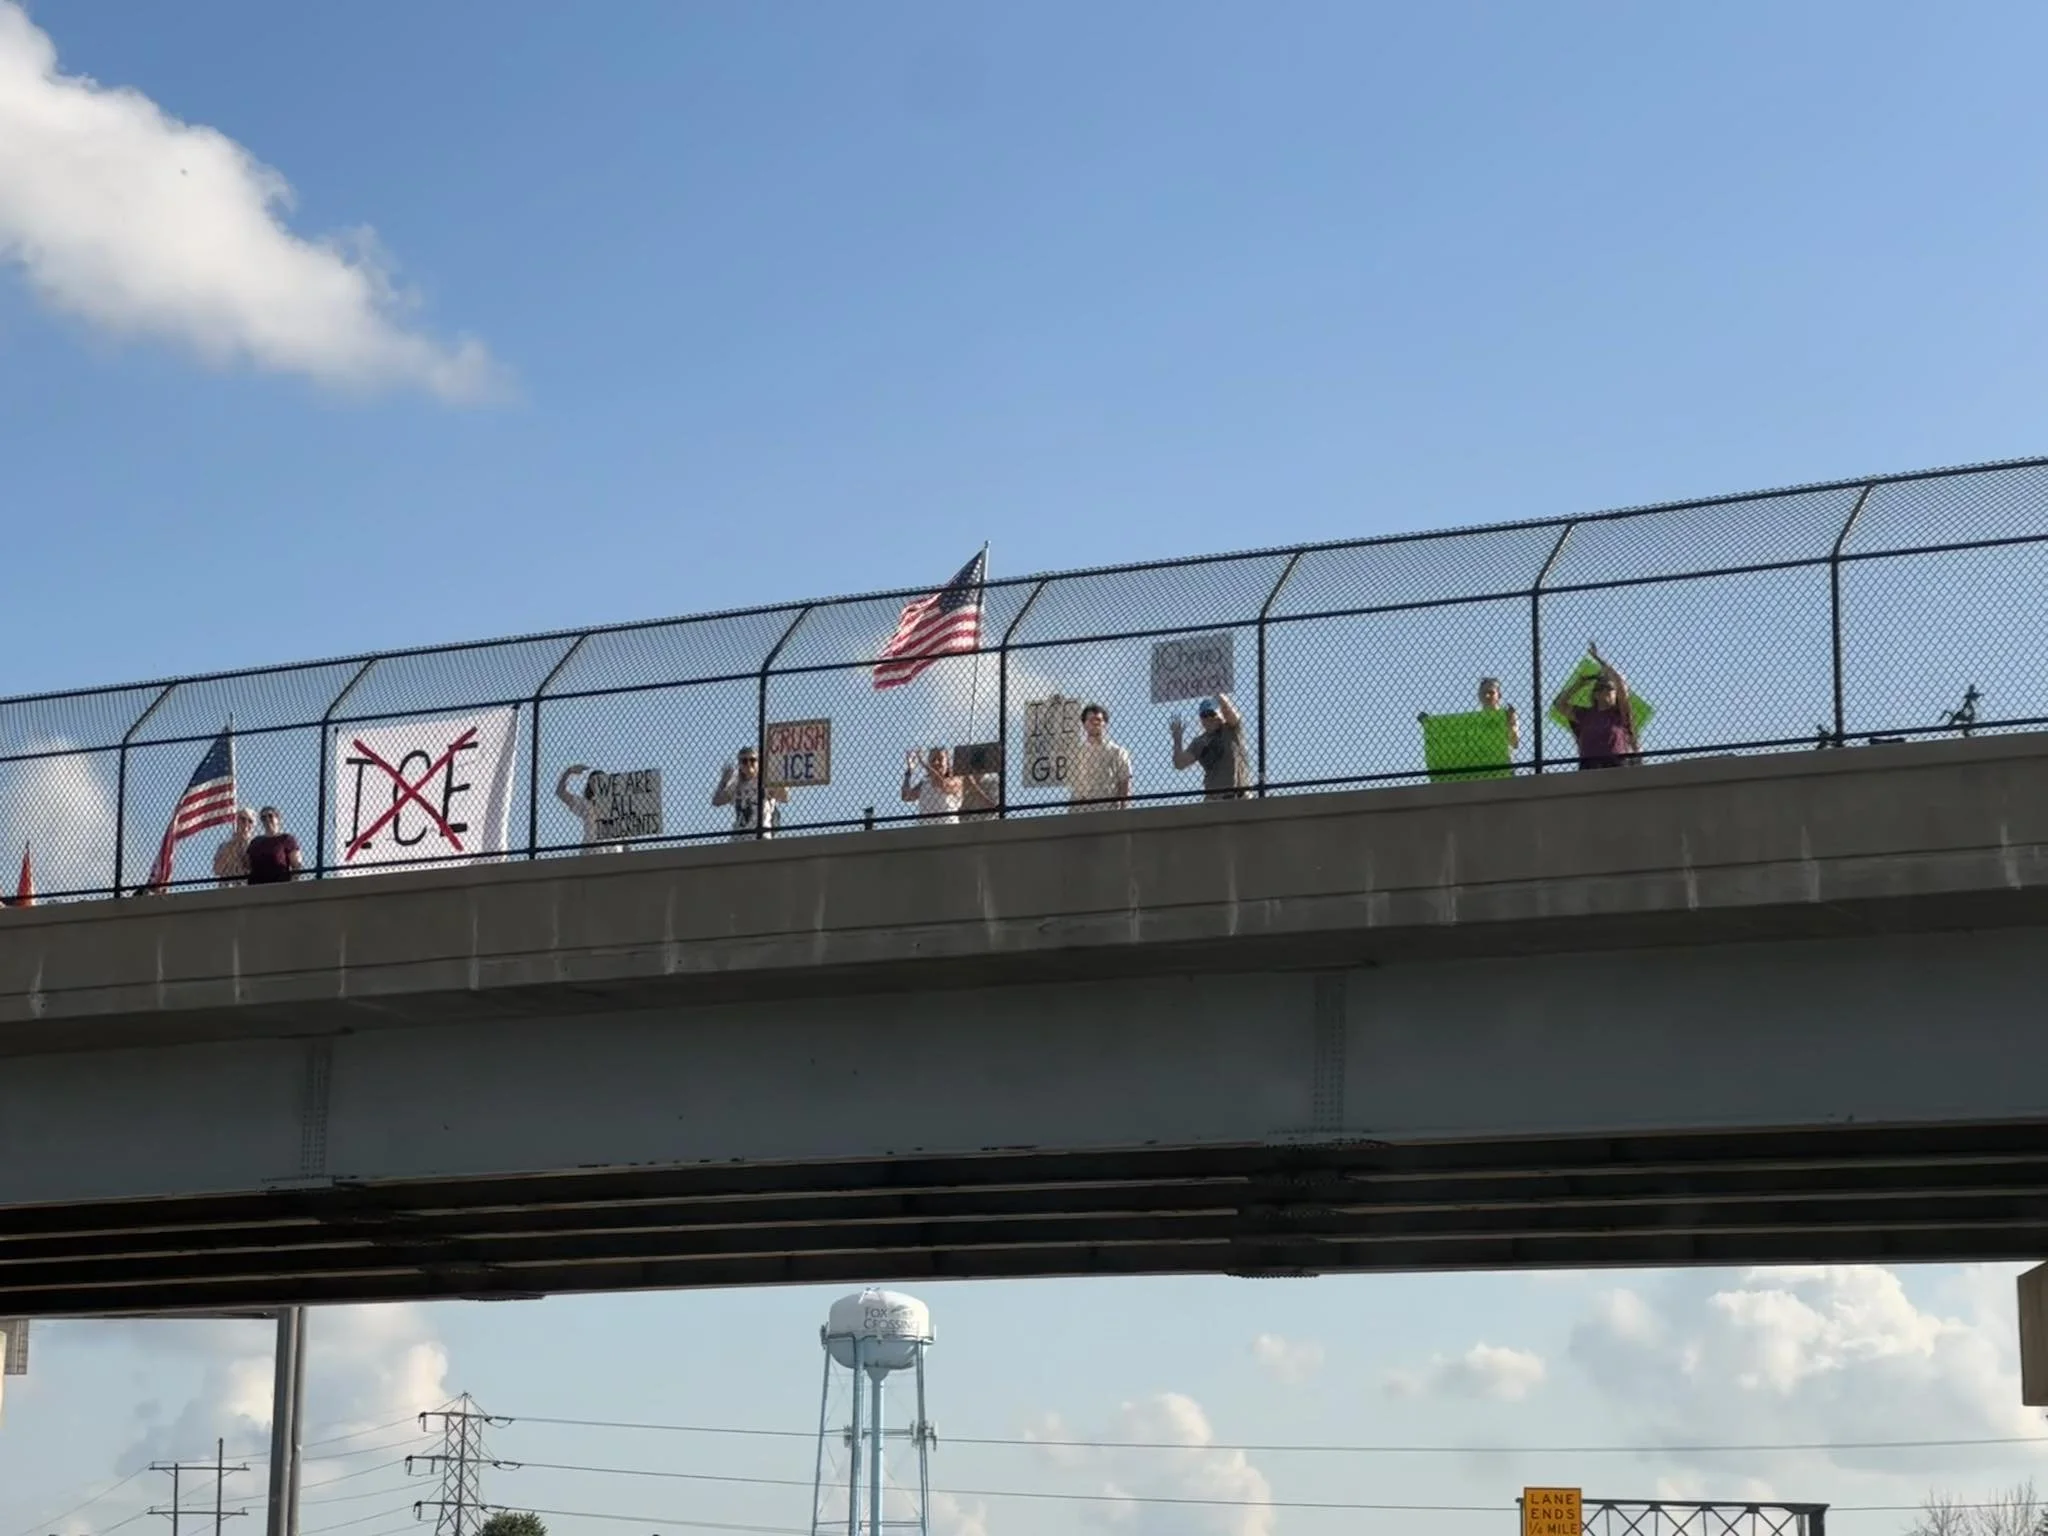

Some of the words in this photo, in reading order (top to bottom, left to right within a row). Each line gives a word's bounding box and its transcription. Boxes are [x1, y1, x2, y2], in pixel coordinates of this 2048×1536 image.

[1029, 700, 1077, 738] ICE
[767, 726, 825, 755] CRUSH
[782, 752, 814, 780] ICE
[1031, 756, 1068, 782] GB
[346, 741, 478, 849] ICE
[596, 773, 621, 797] WE
[625, 769, 652, 793] ARE
[610, 795, 636, 817] ALL
[865, 1307, 888, 1318] FOX
[1530, 1493, 1575, 1505] LANE
[1530, 1508, 1576, 1520] ENDS
[1547, 1523, 1578, 1535] MILE
